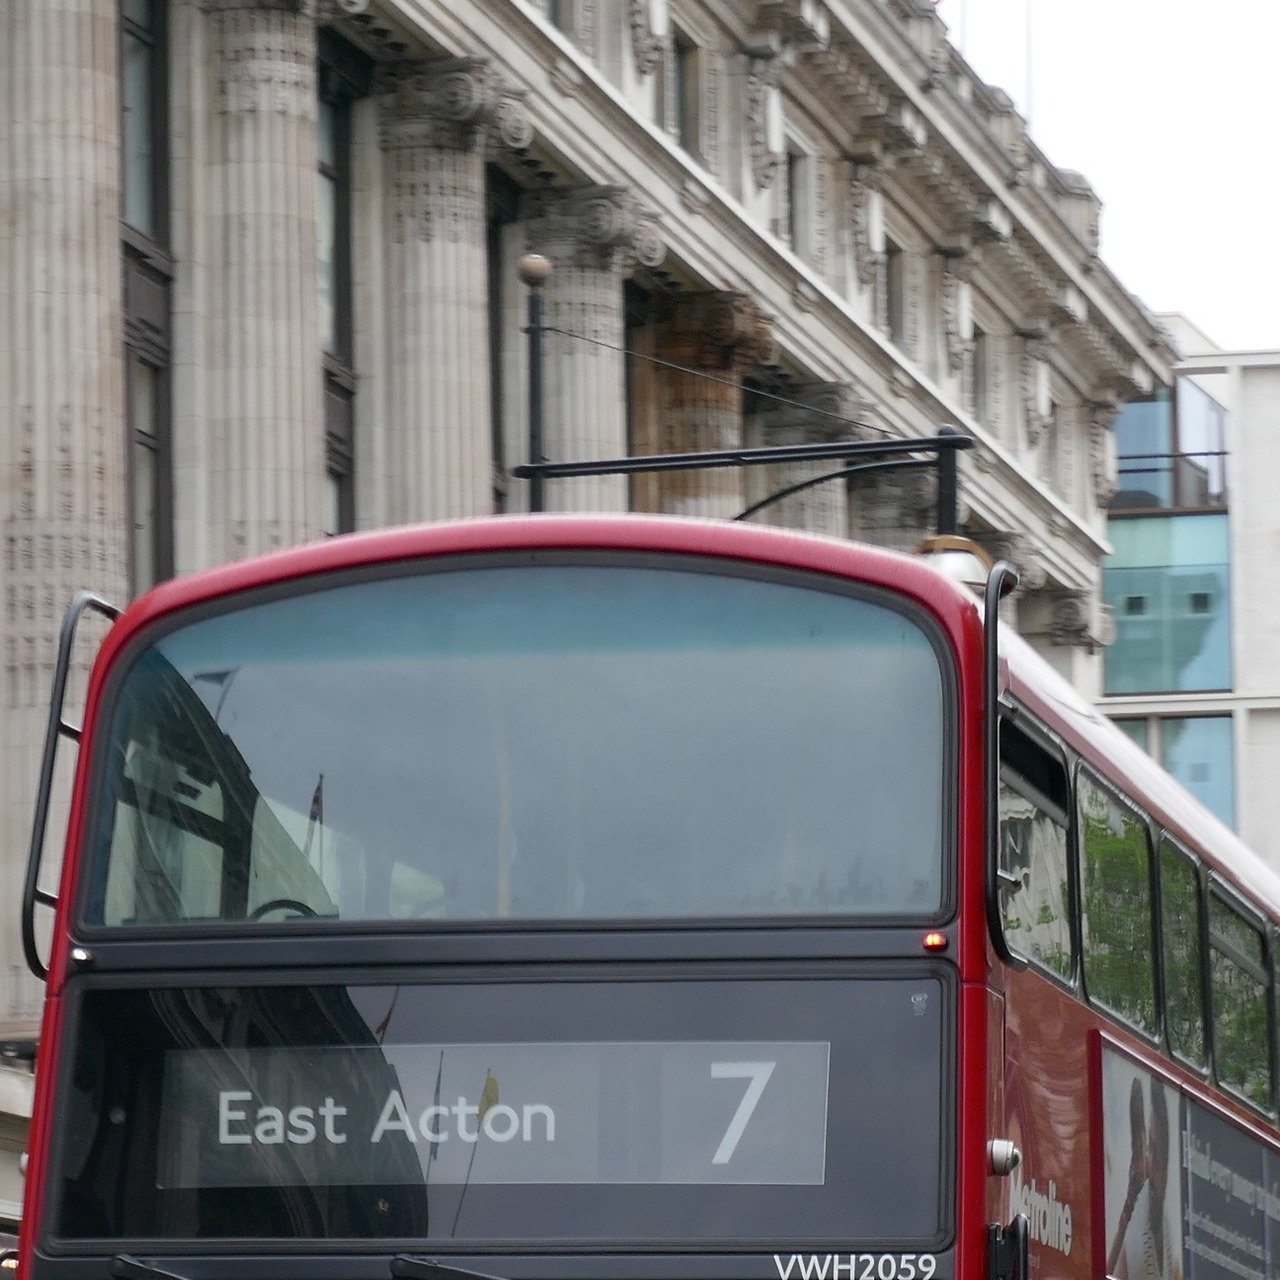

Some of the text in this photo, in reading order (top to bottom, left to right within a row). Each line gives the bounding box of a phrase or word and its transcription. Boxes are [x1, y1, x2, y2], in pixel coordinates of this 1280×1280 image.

[219, 1089, 556, 1145] East Acton
[710, 1061, 777, 1165] 7
[1009, 1164, 1073, 1257] Metroline
